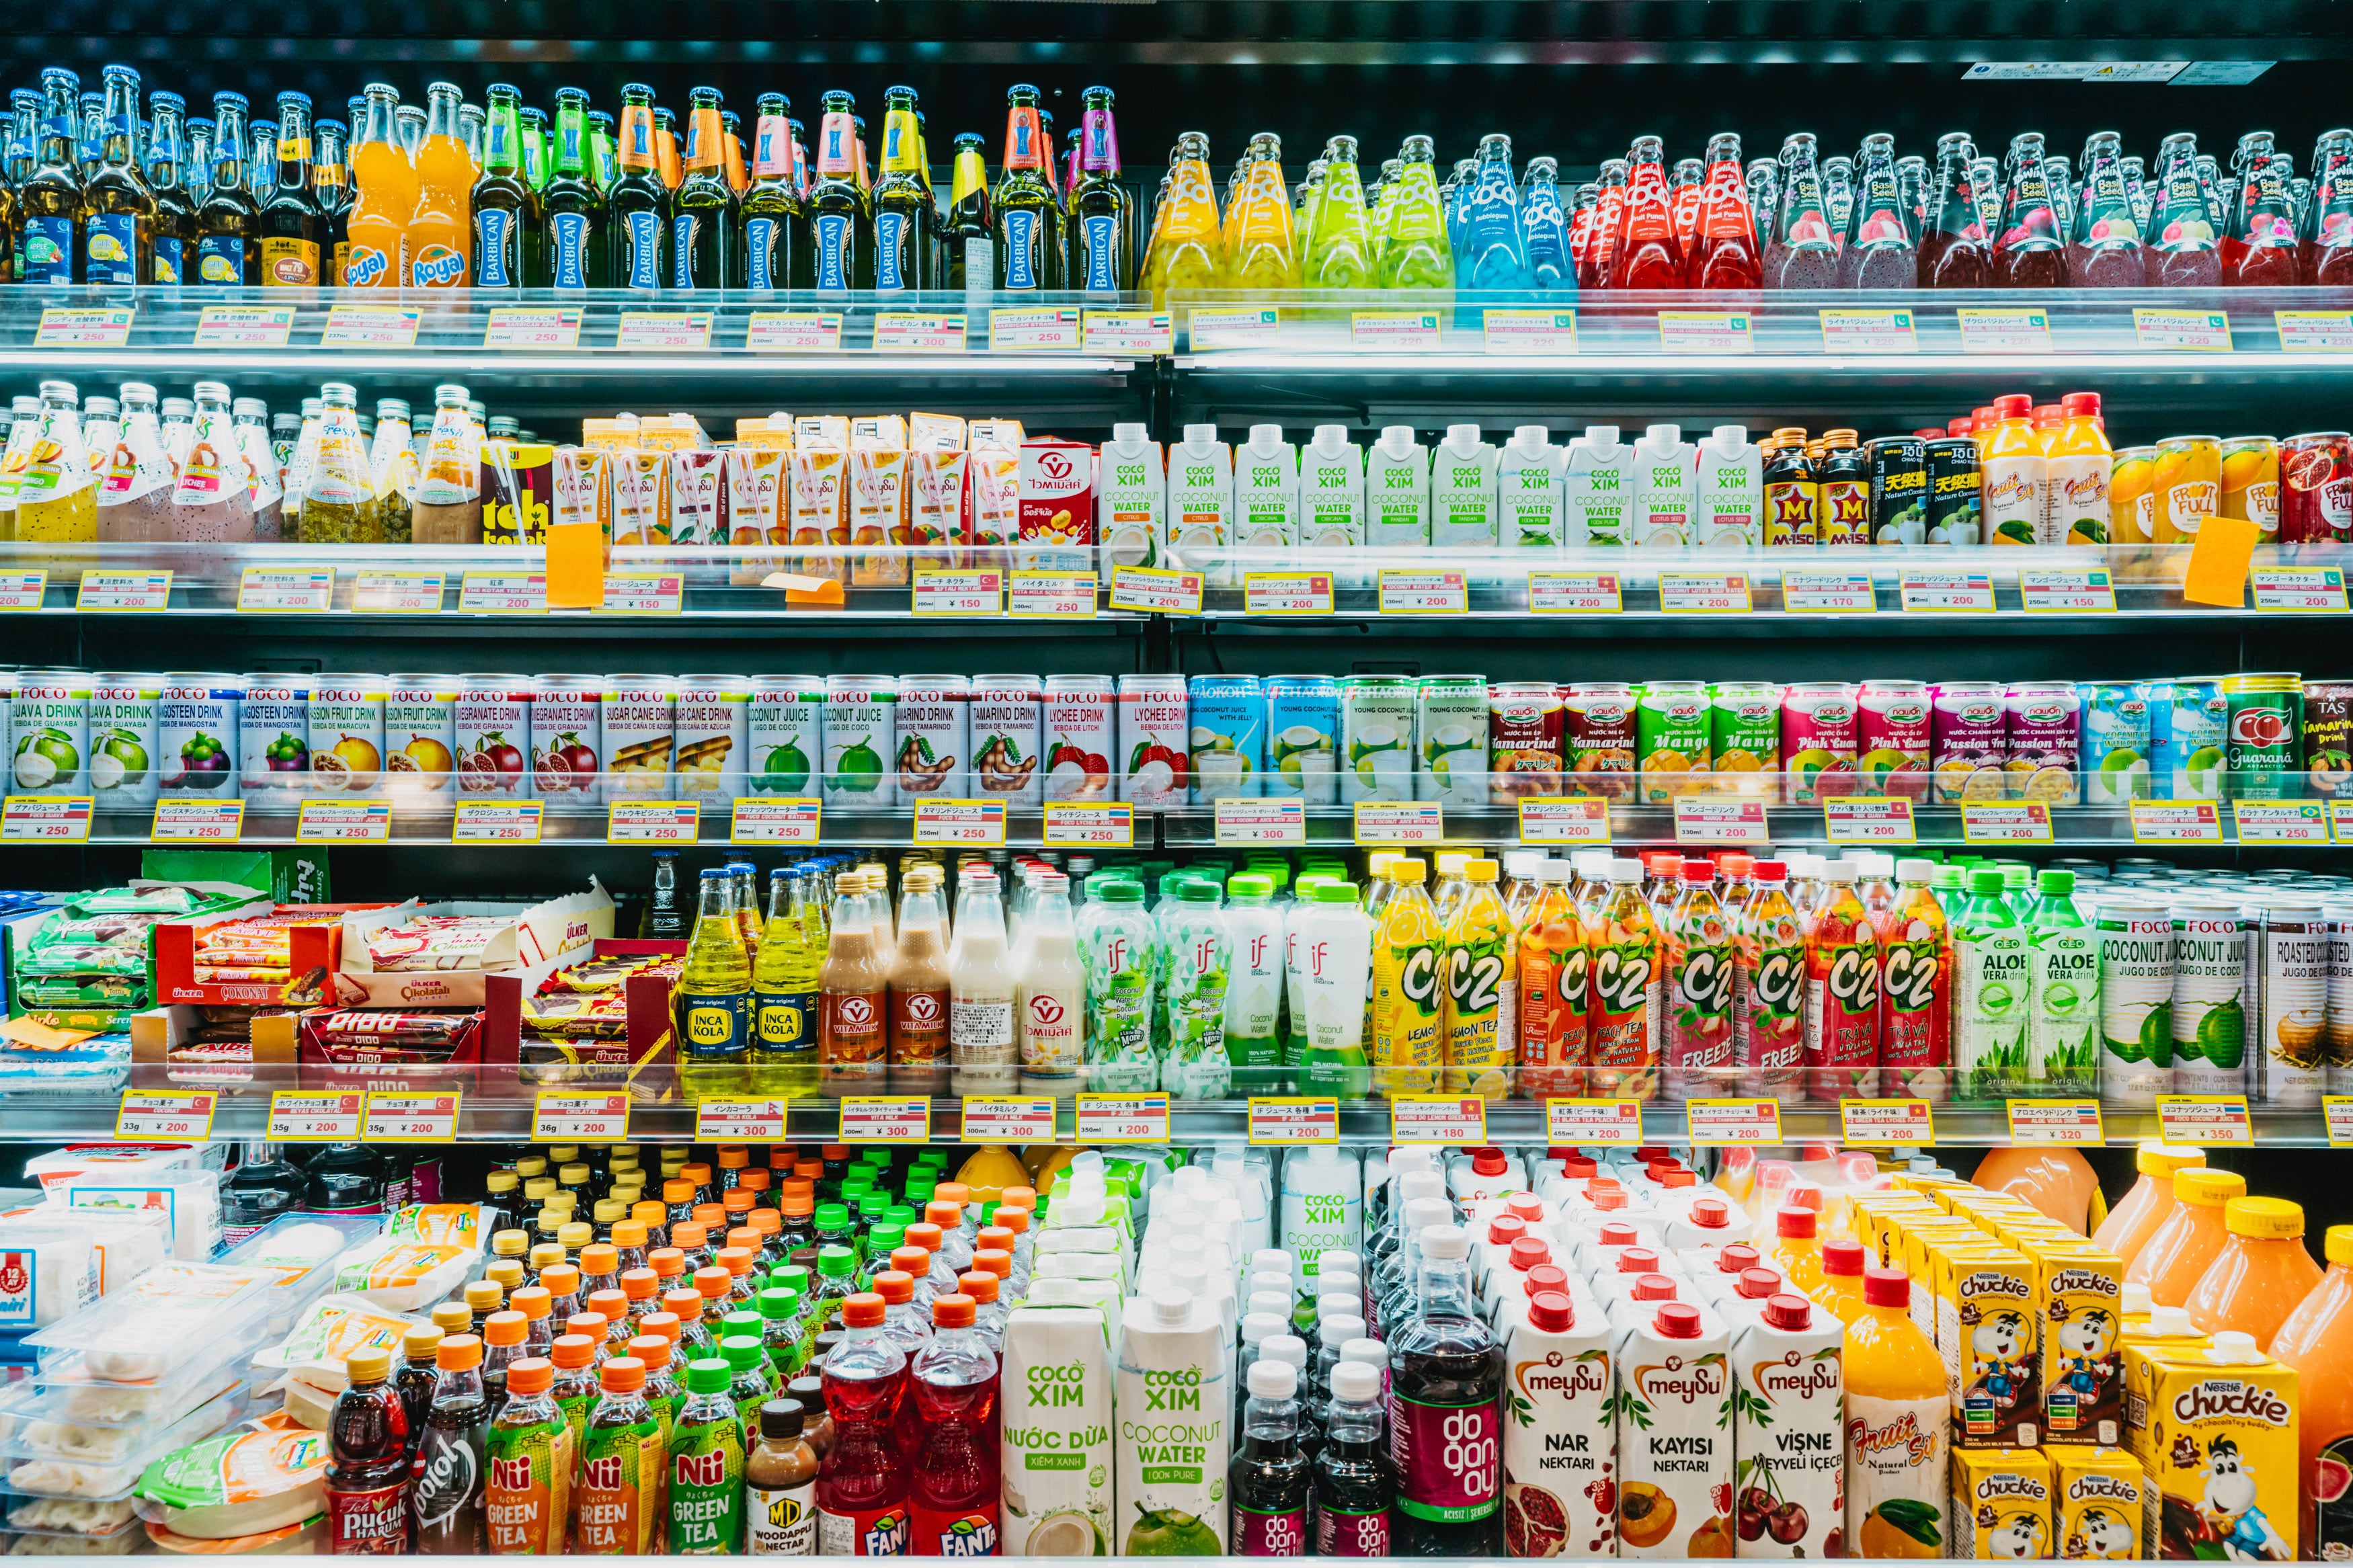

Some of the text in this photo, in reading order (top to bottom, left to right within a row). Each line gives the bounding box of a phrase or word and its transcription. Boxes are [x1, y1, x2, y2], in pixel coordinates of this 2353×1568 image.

[2171, 181, 2194, 190] Basil
[1872, 189, 1895, 198] Seed
[2173, 190, 2194, 198] Seed
[486, 215, 499, 282] BARBICAN
[563, 219, 576, 286] BARBICAN
[883, 219, 894, 286] BARBICAN
[1014, 216, 1027, 284] BARBICAN
[1095, 222, 1106, 288] BARBICAN
[414, 252, 465, 286] Royal
[535, 333, 557, 341] 250
[922, 338, 945, 346] 300
[1039, 333, 1060, 341] 250
[2188, 337, 2209, 345] 220
[1117, 474, 1146, 486] XIM
[1105, 491, 1159, 501] COCONUT
[1240, 493, 1294, 503] COCONUT
[1114, 503, 1150, 511] WATER
[1249, 504, 1285, 512] WATER
[1516, 505, 1552, 515] WATER
[2179, 501, 2213, 513] FULL
[124, 597, 145, 606] 200
[506, 599, 528, 608] 200
[2305, 597, 2327, 606] 200
[1055, 603, 1078, 612] 250
[21, 688, 66, 699] FOCO
[319, 690, 360, 701] FOCO
[1057, 692, 1096, 703] FOCO
[46, 705, 82, 718] DRINK
[2317, 702, 2345, 714] TAS
[331, 708, 375, 720] FRUIT DRINK
[607, 708, 653, 720] SUGAR CANE
[785, 708, 809, 721] JUICE
[973, 708, 1036, 720] TAMARIND DRINK
[1049, 709, 1104, 722] LYCHEE DRINK
[1654, 736, 1708, 747] Mango
[1799, 737, 1826, 749] Pink
[2318, 734, 2345, 744] Drink
[2230, 748, 2292, 769] Guaraná
[1515, 760, 1556, 770] タマリンド
[500, 829, 522, 837] 250
[1263, 830, 1283, 838] 300
[1725, 829, 1746, 837] 200
[567, 922, 588, 938] ÜLKER
[2188, 921, 2234, 932] FOCO
[2048, 954, 2094, 969] ALOE
[2048, 970, 2095, 980] VERA drink
[2215, 966, 2240, 976] COCO
[1450, 948, 1503, 1008] C2
[1885, 948, 1938, 1007] C2
[173, 988, 203, 998] ÜLKER
[221, 986, 268, 999] ÇOKONAT
[1115, 987, 1141, 995] Coconut
[696, 1014, 723, 1026] INCA
[694, 1024, 724, 1036] KOLA
[834, 1022, 878, 1033] VITAMILK
[1316, 1026, 1343, 1034] Coconut
[1597, 1023, 1642, 1037] PEACH TEA
[1317, 1036, 1335, 1044] Water
[1599, 1037, 1639, 1048] BREWED FROM
[1683, 1037, 1732, 1072] FREEZE
[142, 1098, 173, 1107] チョコ菓子
[278, 1098, 336, 1107] ホワイトチョコ菓子
[541, 1122, 605, 1132] 36g 200
[744, 1126, 766, 1136] 300
[1126, 1124, 1149, 1134] 200
[1443, 1128, 1464, 1137] 180
[1739, 1130, 1759, 1139] 200
[2060, 1130, 2081, 1139] 320
[2210, 1130, 2233, 1139] 350
[7, 1269, 19, 1278] 12
[1028, 1384, 1084, 1407] XIM
[1004, 1428, 1060, 1447] NƯỚC
[1123, 1421, 1221, 1443] COCONUT
[1546, 1435, 1588, 1452] NAR
[1776, 1429, 1831, 1454] VİŞNE
[1849, 1412, 1915, 1464] Fruit
[1650, 1438, 1712, 1455] KAYISI
[1138, 1446, 1205, 1462] WATER
[1056, 1457, 1080, 1467] XANH
[1540, 1457, 1594, 1470] NEKTARI
[1654, 1460, 1708, 1472] NEKTARI
[1753, 1454, 1806, 1471] MEYVELİ
[1868, 1459, 1907, 1469] Natural
[1148, 1470, 1195, 1479] 100% PURE
[488, 1502, 537, 1524] GREEN
[674, 1495, 729, 1520] GREEN
[770, 1500, 800, 1524] MD
[1444, 1509, 1464, 1518] ACISIZ
[344, 1501, 406, 1539] pucuk
[356, 1520, 401, 1538] HARUM
[682, 1522, 718, 1542] TEA
[756, 1525, 811, 1540] WOODAPPLE
[496, 1528, 526, 1544] TEA
[941, 1526, 997, 1557] FANTA
[766, 1539, 803, 1551] NECTAR
